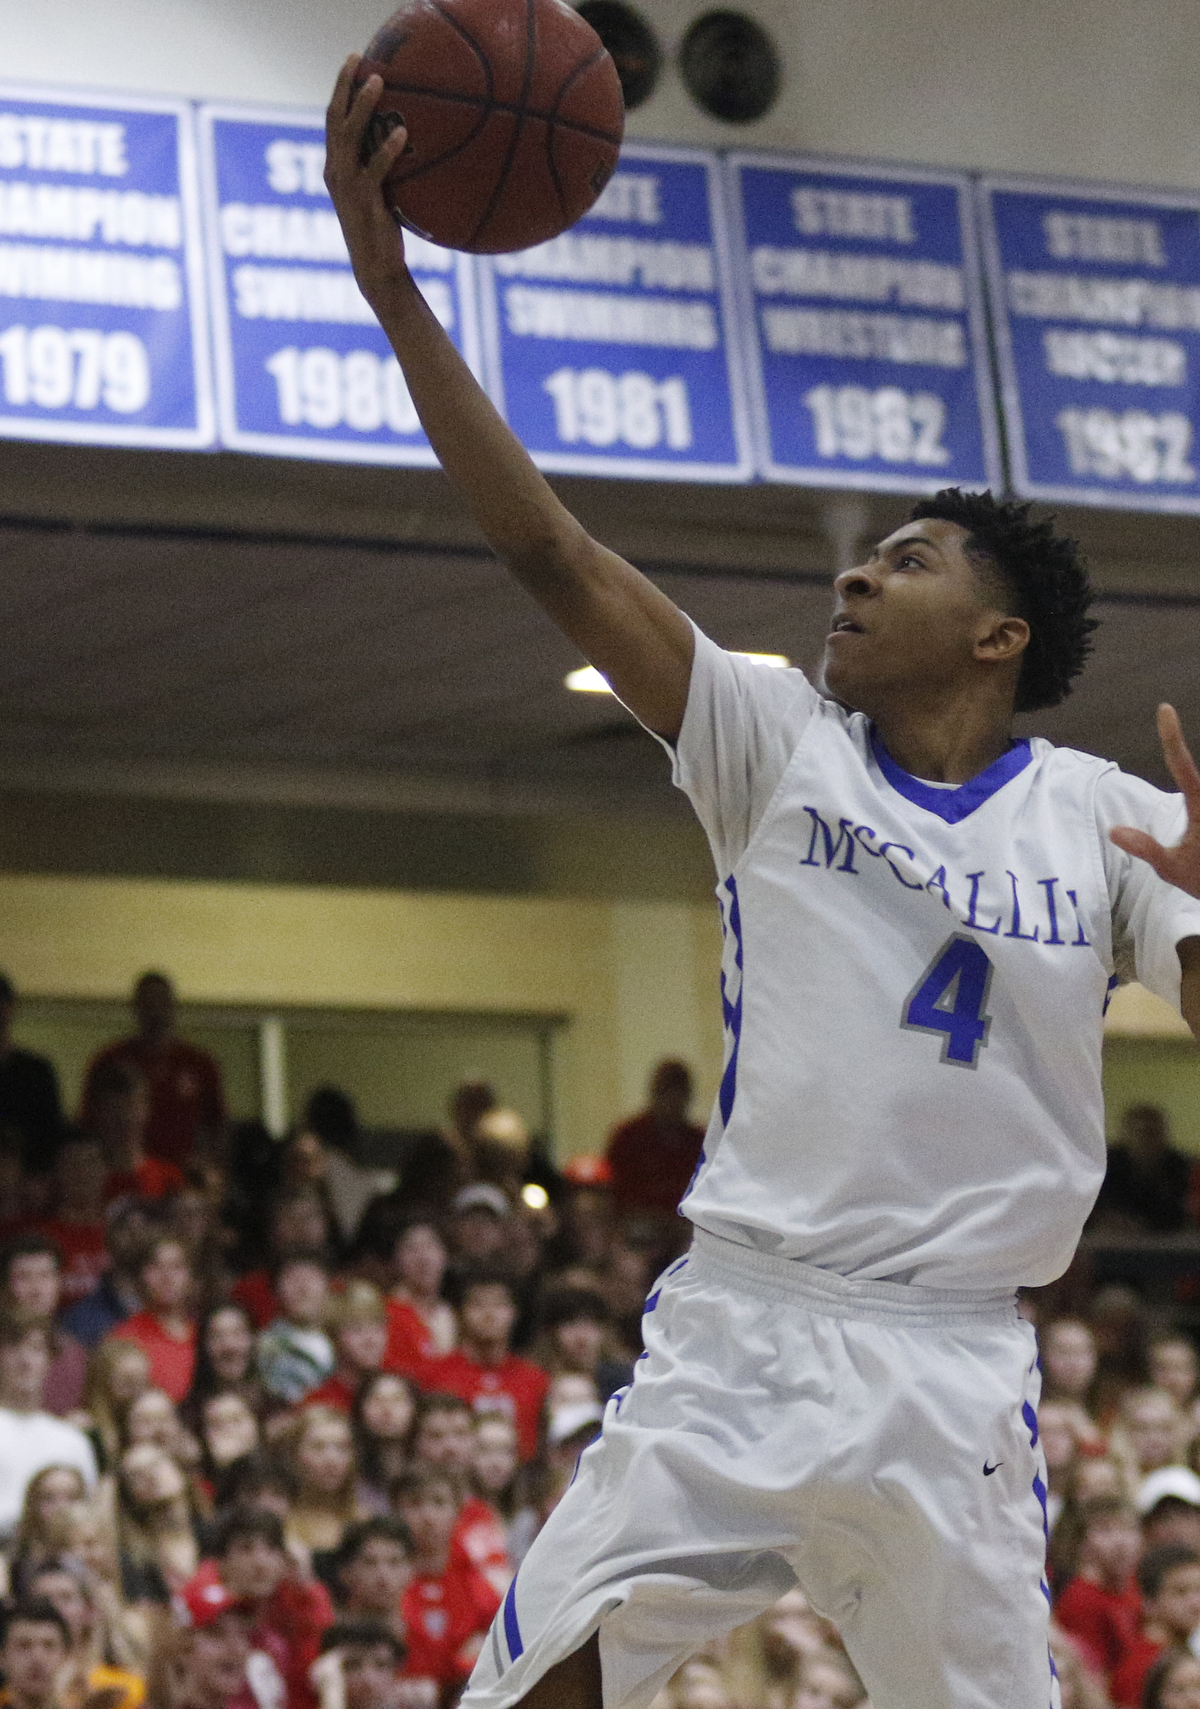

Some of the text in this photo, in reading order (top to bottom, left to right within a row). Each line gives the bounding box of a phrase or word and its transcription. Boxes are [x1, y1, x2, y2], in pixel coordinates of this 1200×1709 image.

[0, 113, 129, 177] STATE
[792, 187, 917, 243] STATE
[1043, 213, 1167, 267] STATE
[752, 246, 964, 310] CHAMPION
[0, 325, 151, 414] 1979
[544, 367, 693, 450] 1981
[805, 382, 951, 466] 1982
[1057, 407, 1198, 485] 1982
[899, 931, 995, 1071] 4
